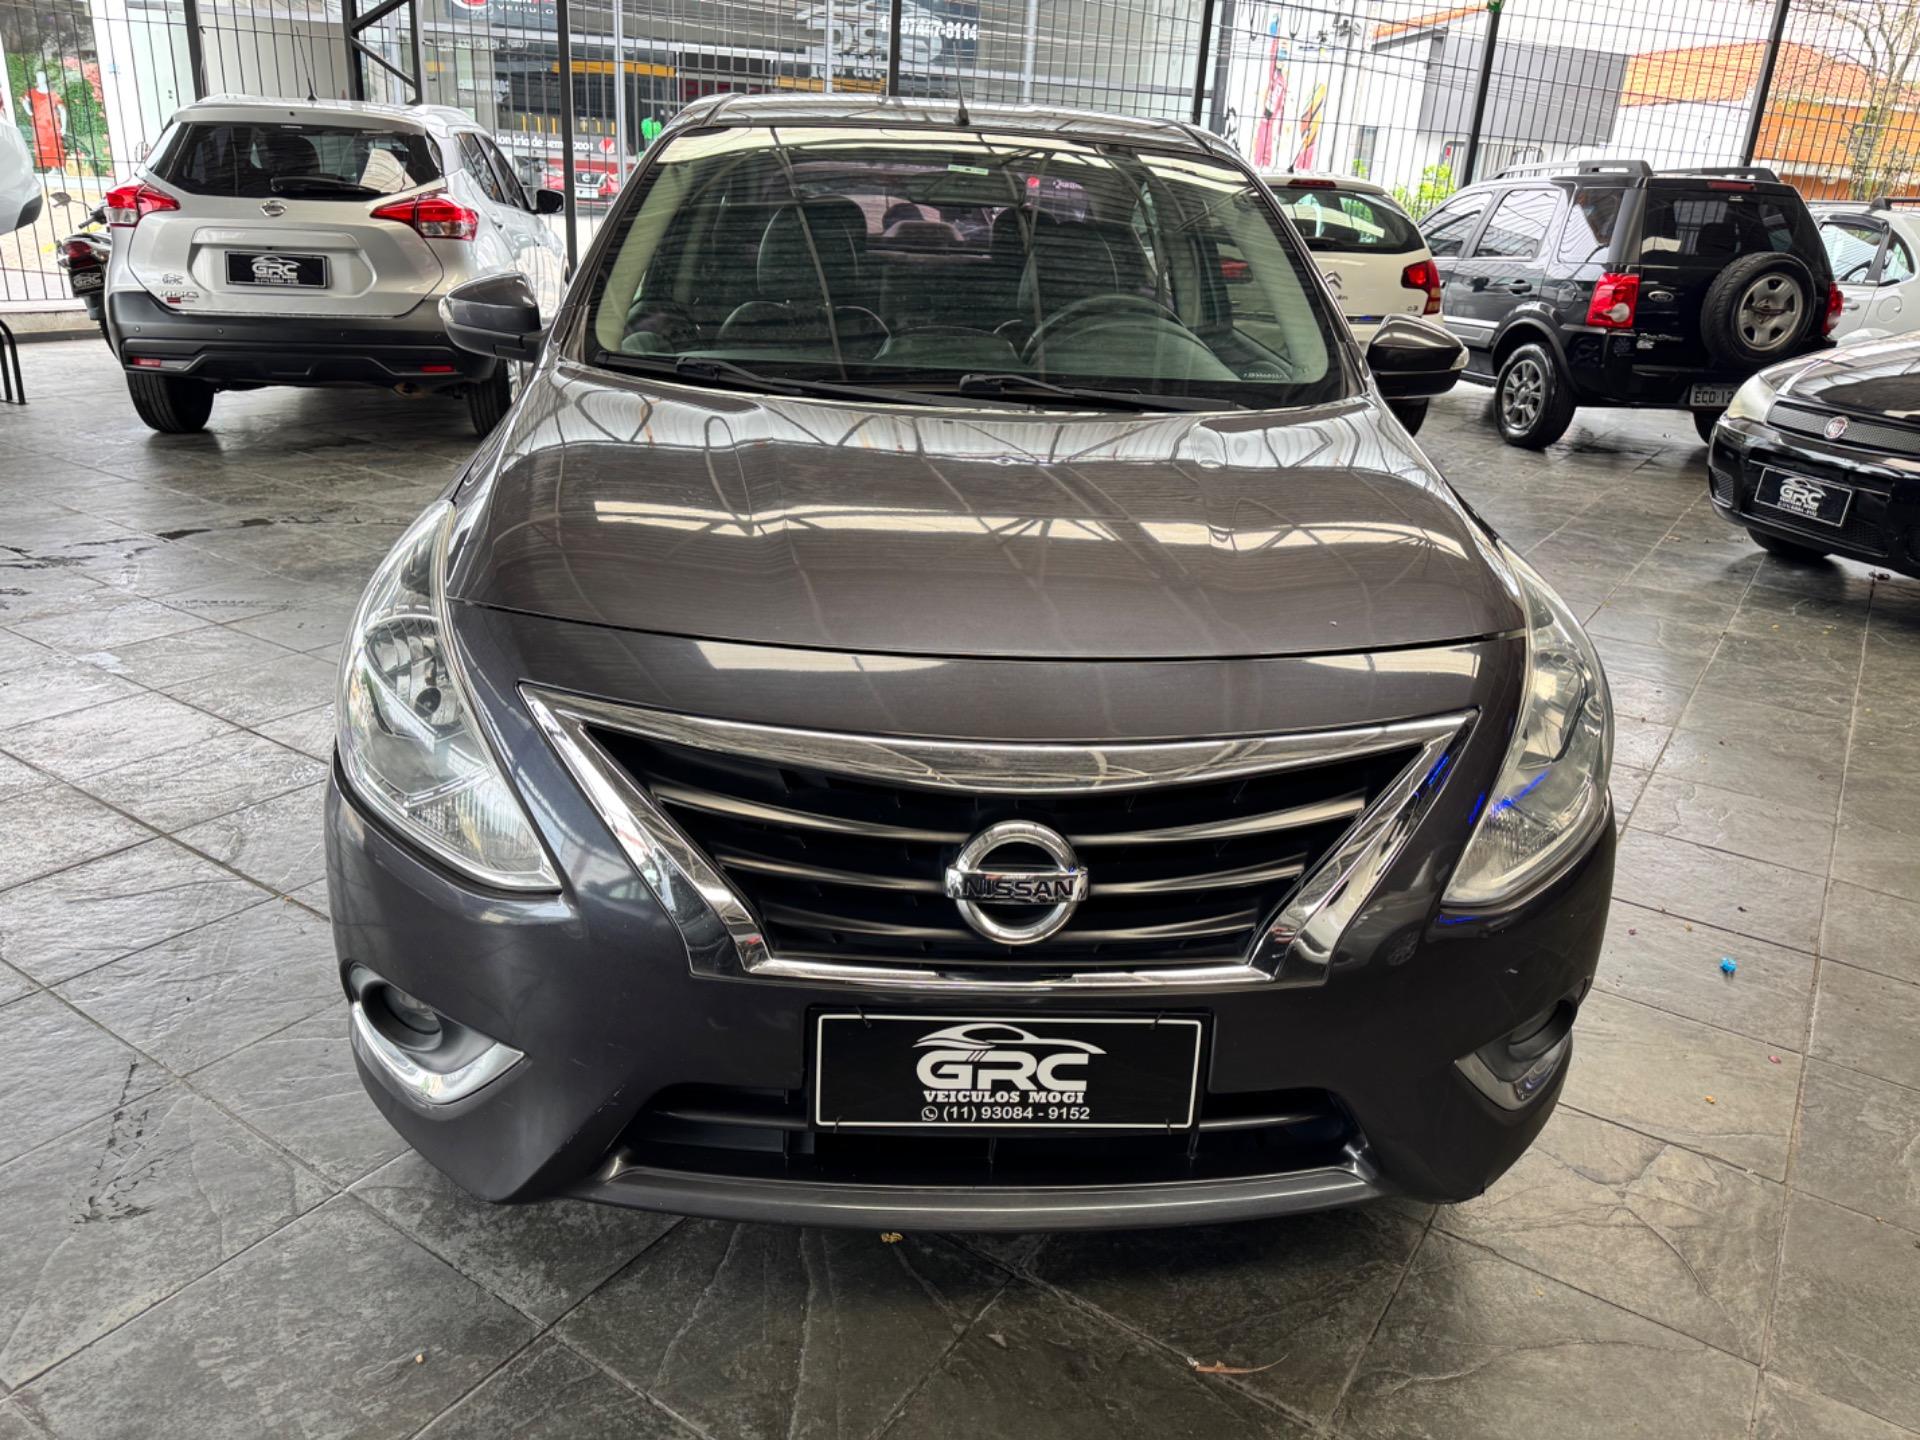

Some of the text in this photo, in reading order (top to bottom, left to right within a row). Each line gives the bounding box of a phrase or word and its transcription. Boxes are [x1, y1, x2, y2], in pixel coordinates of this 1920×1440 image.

[252, 262, 298, 279] GRC
[1780, 484, 1822, 510] GRC
[963, 879, 1074, 897] NISSAN
[916, 1050, 1089, 1091] GRC
[923, 1090, 1084, 1104] VEICULOS MOGI
[943, 1106, 977, 1122] (11)
[981, 1106, 1034, 1119] 93084
[1048, 1107, 1090, 1120] 9152
